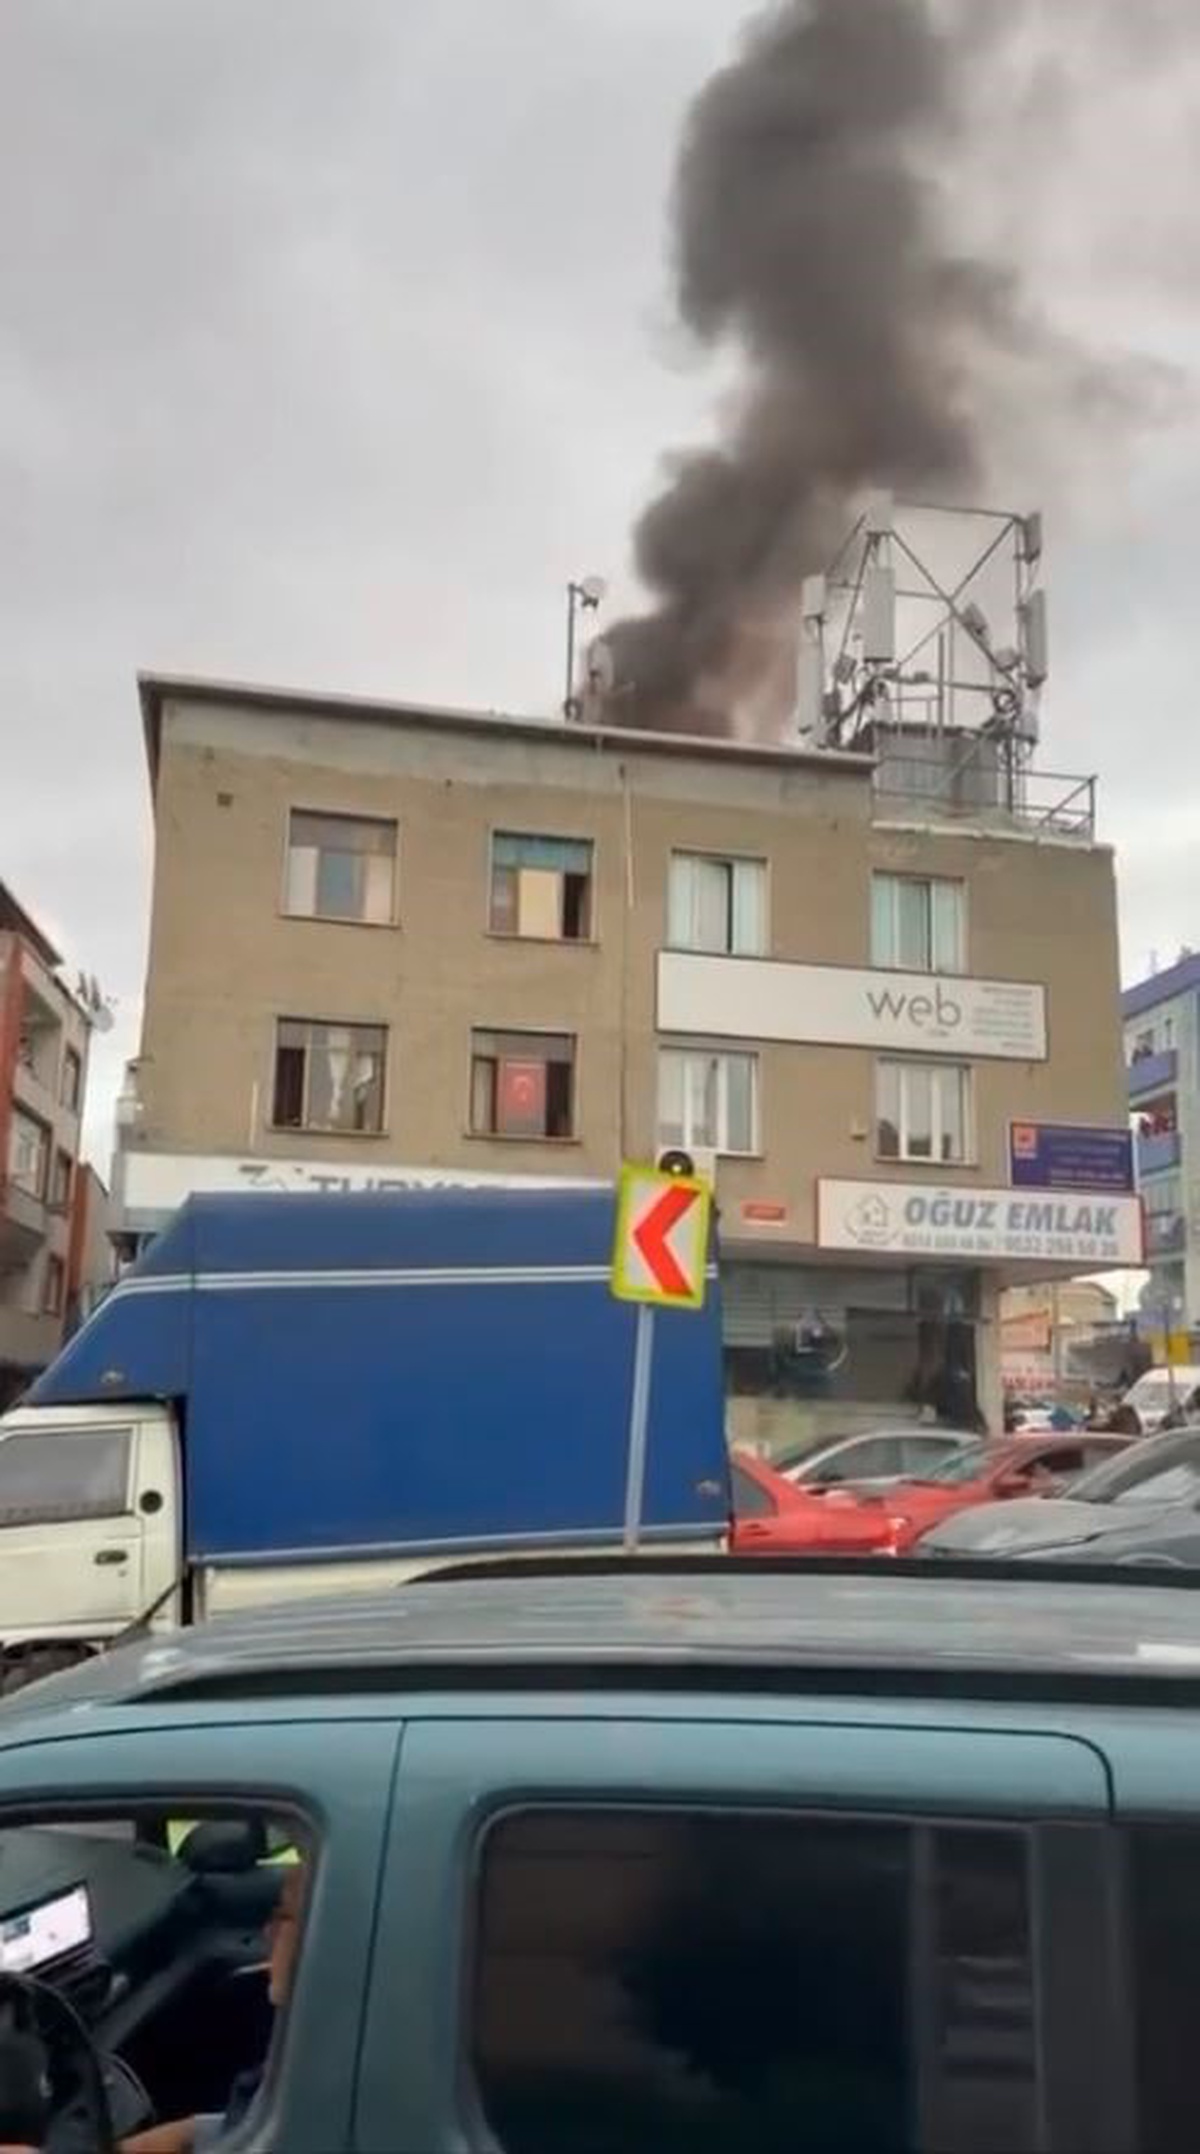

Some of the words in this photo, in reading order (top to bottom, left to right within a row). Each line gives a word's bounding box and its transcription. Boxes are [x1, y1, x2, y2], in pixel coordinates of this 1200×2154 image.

[866, 981, 962, 1028] web
[904, 1190, 999, 1229] OĞUZ
[1007, 1202, 1118, 1235] EMLAK
